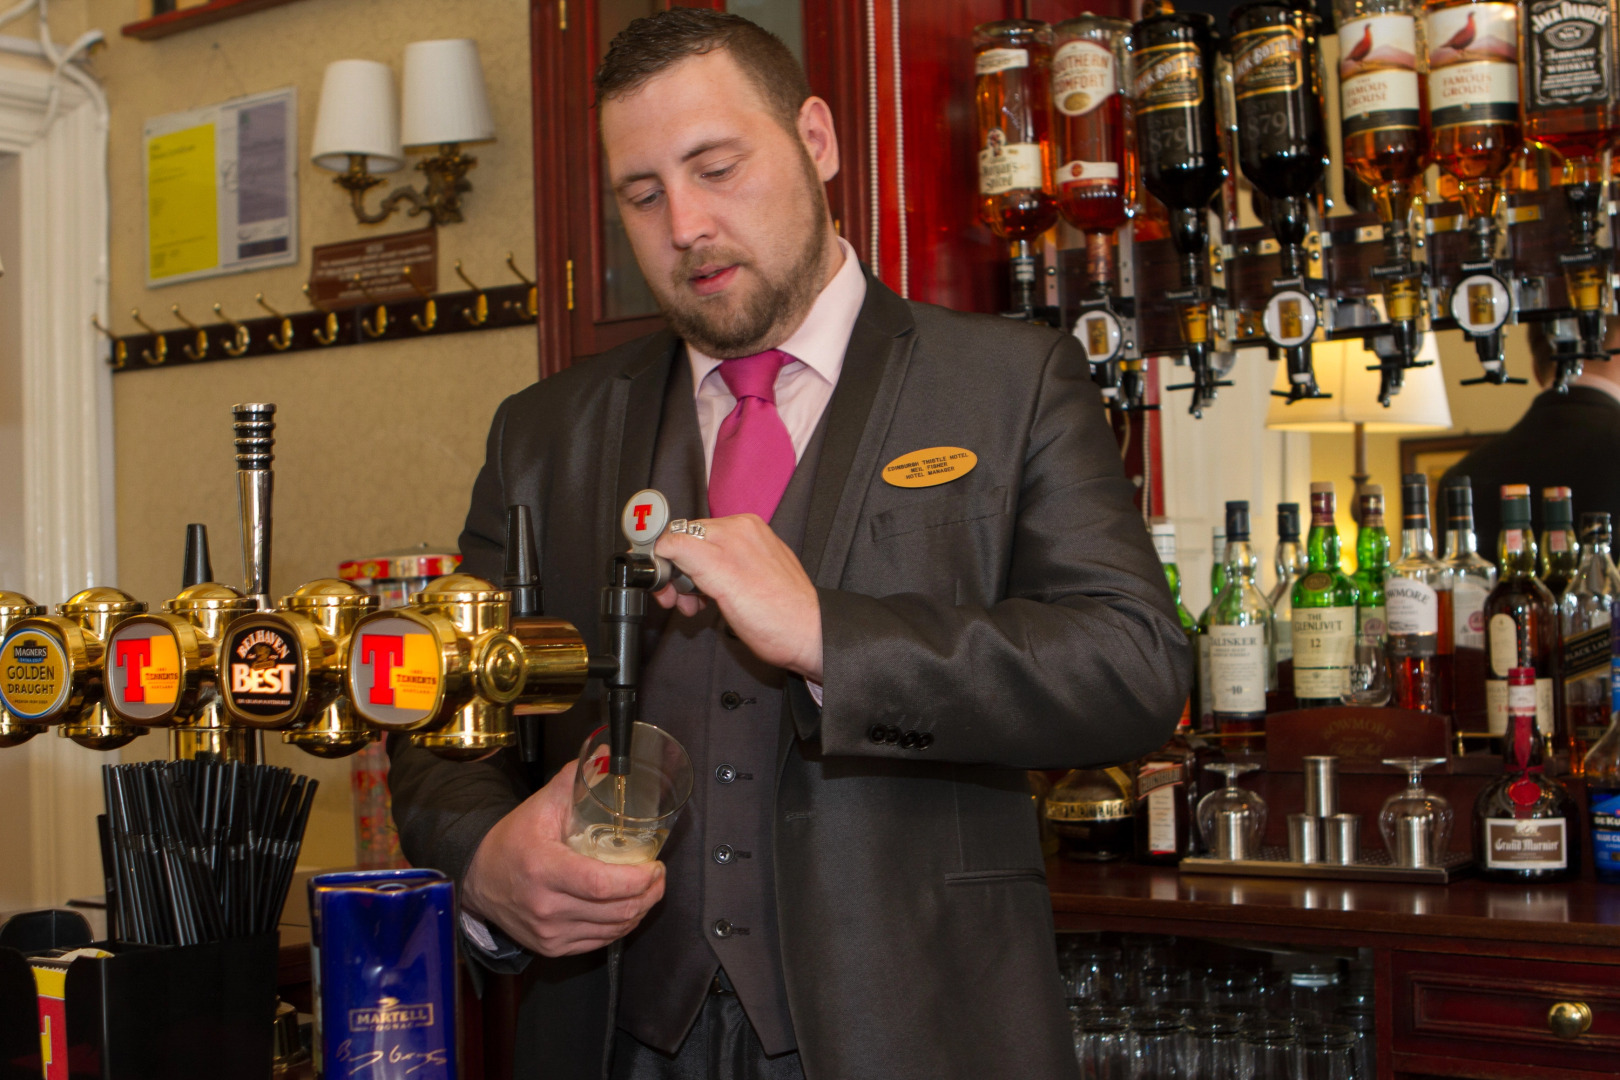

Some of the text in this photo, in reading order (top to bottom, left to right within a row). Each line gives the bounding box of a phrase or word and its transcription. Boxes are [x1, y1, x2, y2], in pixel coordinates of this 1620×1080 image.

[887, 452, 968, 472] EDINBURGH THISTLE HOTEL
[926, 461, 948, 470] FISHER
[905, 466, 955, 480] HOTEL MANAGER
[633, 504, 653, 531] T
[236, 629, 290, 660] BELHAVEN
[1310, 638, 1322, 648] 12
[14, 647, 47, 657] MAGNERS
[7, 665, 55, 680] GOLDEN
[116, 638, 150, 702] T
[362, 634, 403, 705] T
[231, 663, 296, 695] BEST
[7, 683, 55, 695] DRAUGHT
[1495, 838, 1559, 851] Grand Marnier
[357, 1009, 427, 1025] MARTELL
